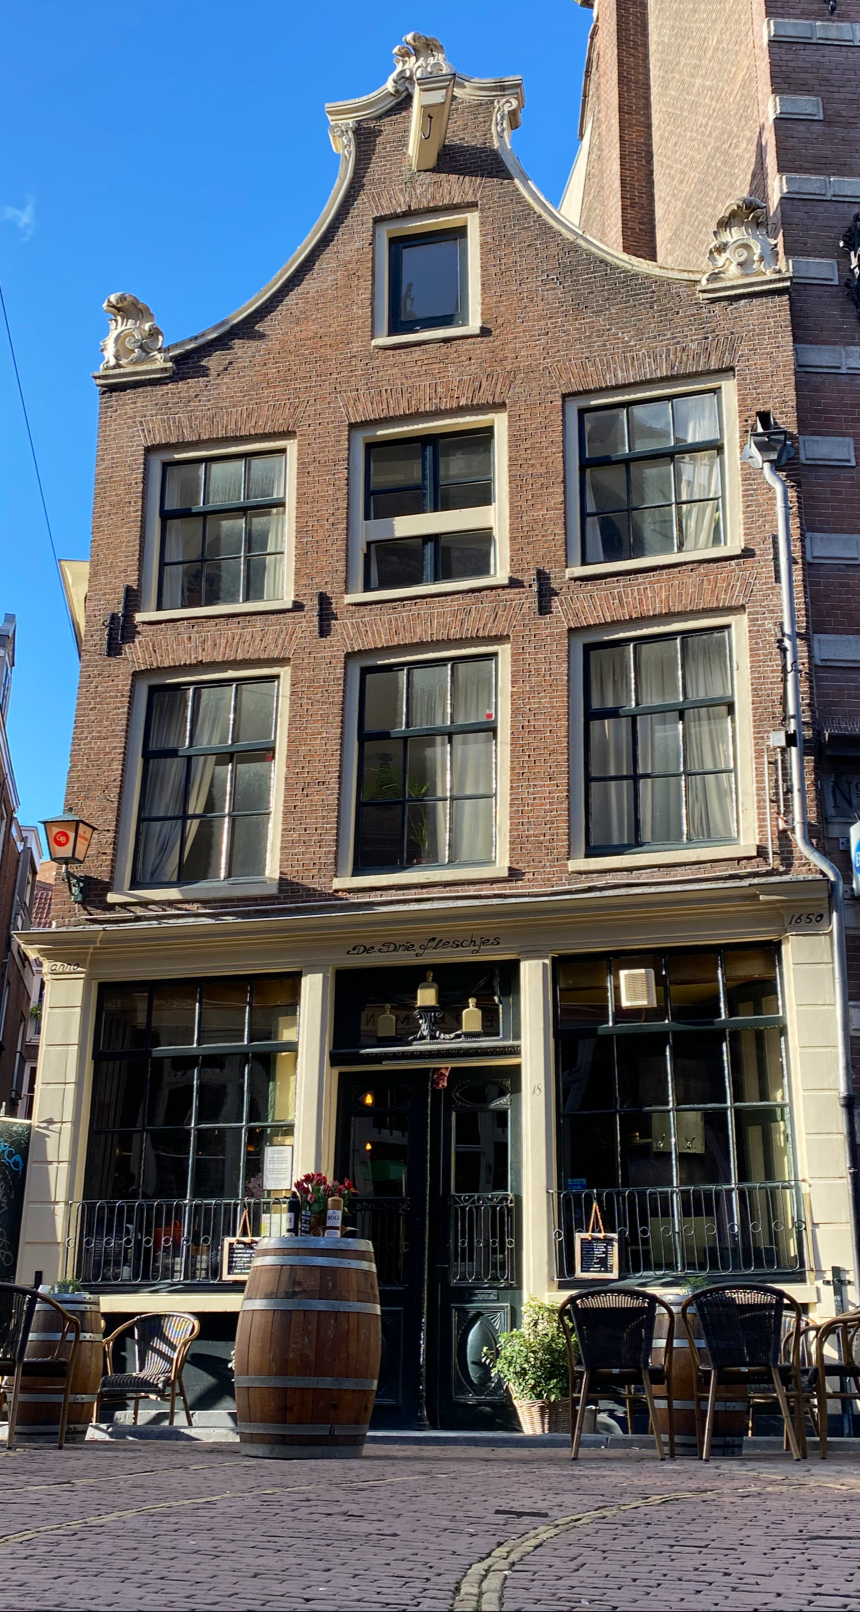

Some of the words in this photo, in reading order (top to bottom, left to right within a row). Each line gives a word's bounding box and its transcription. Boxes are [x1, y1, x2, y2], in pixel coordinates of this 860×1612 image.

[789, 913, 824, 925] 1650
[347, 944, 376, 955] De
[378, 941, 417, 953] Drie
[532, 1083, 542, 1096] 18
